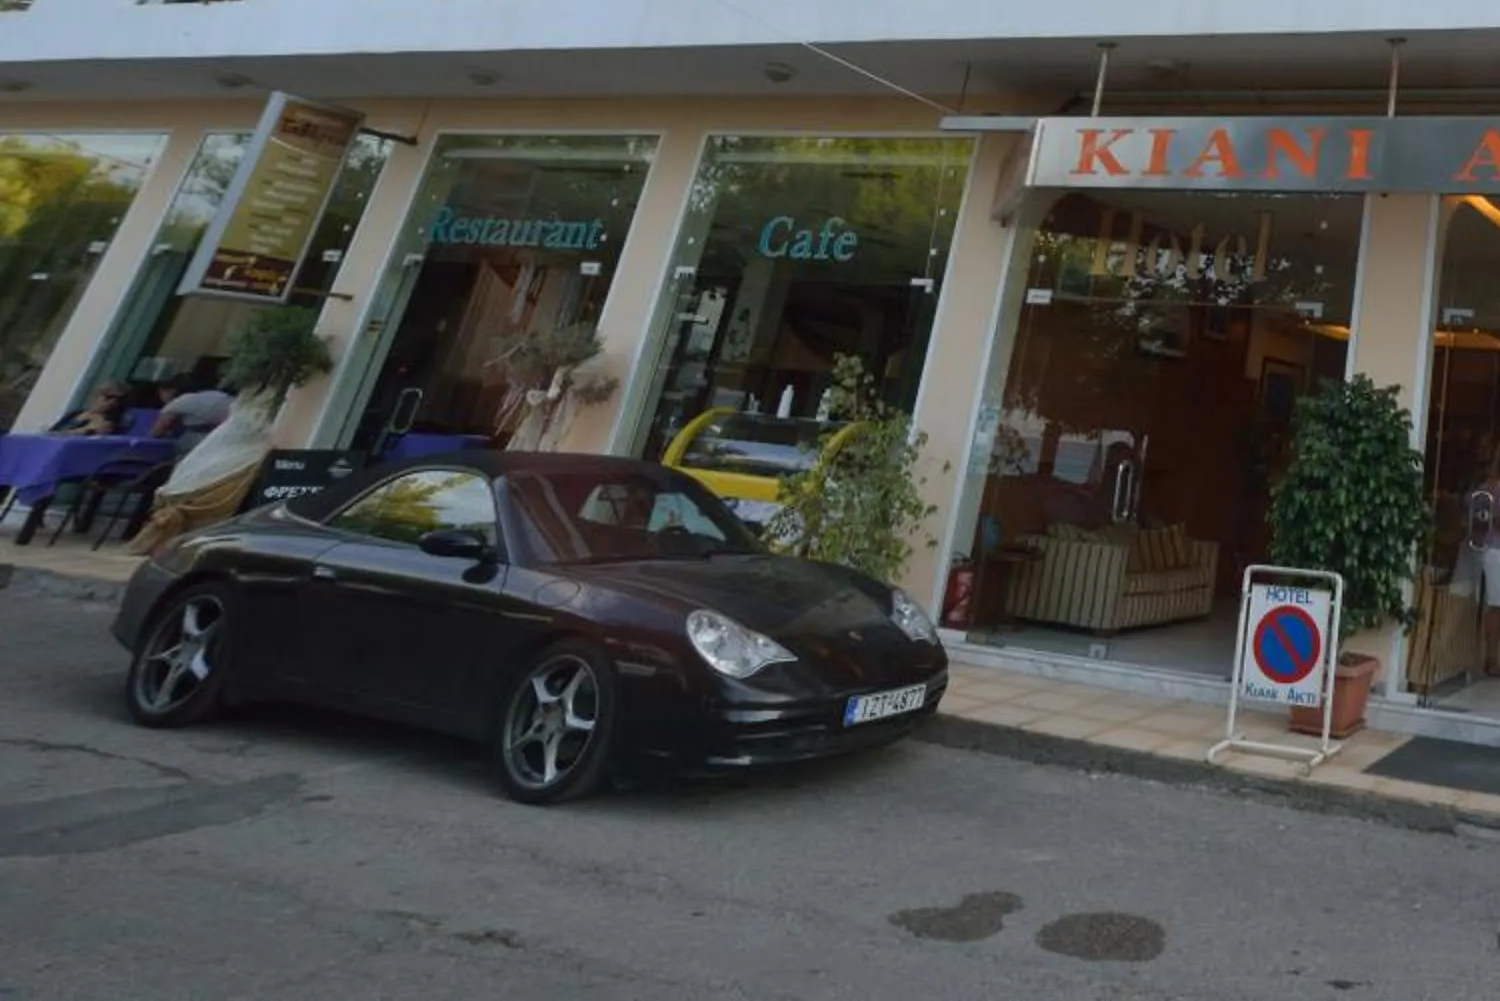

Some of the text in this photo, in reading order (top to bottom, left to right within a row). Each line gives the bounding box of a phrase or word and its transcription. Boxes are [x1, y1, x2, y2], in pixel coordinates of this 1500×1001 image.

[1069, 128, 1377, 180] KIANI
[427, 204, 602, 251] Restaurant
[1265, 586, 1314, 604] HOTEL
